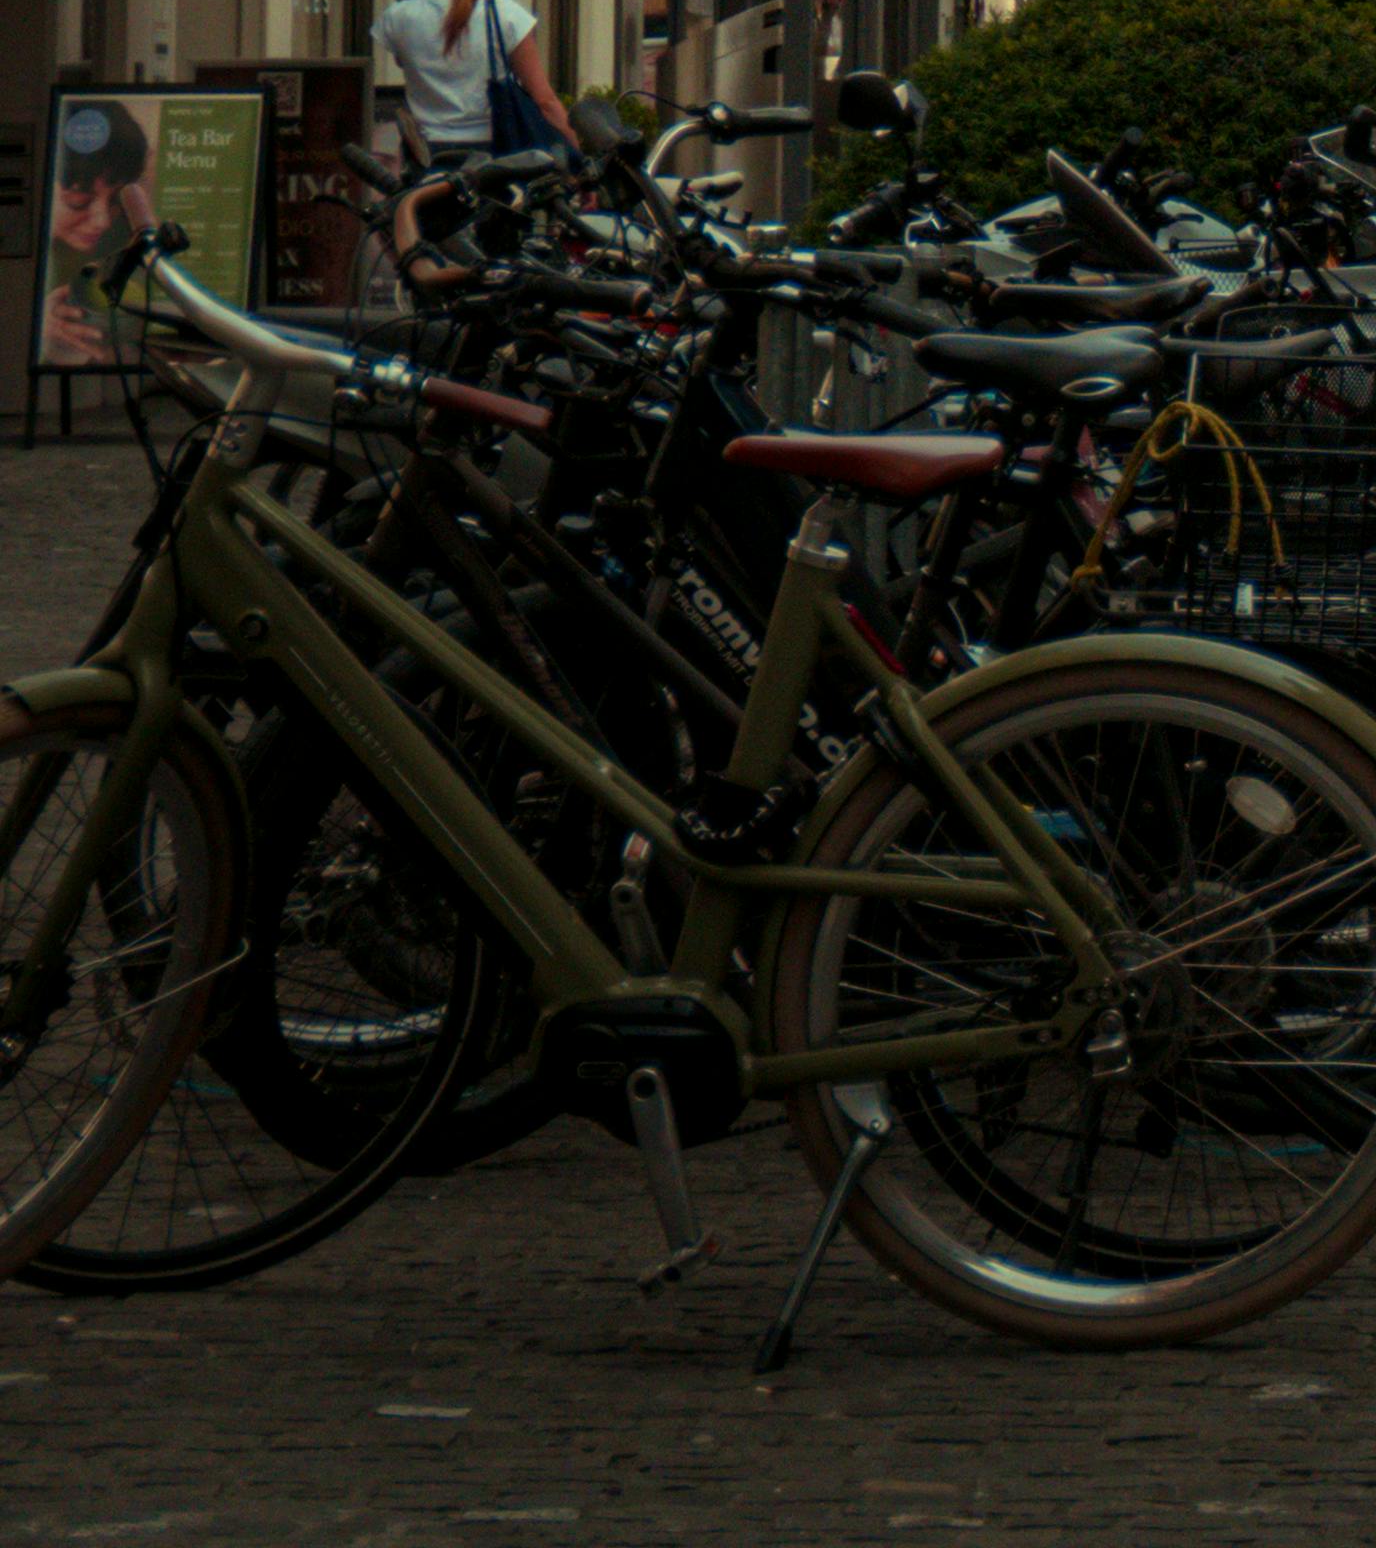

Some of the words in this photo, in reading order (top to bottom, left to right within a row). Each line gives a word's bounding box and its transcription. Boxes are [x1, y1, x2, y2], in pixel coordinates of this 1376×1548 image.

[167, 128, 198, 147] Tea
[202, 128, 234, 146] Bar
[165, 151, 218, 169] Menu
